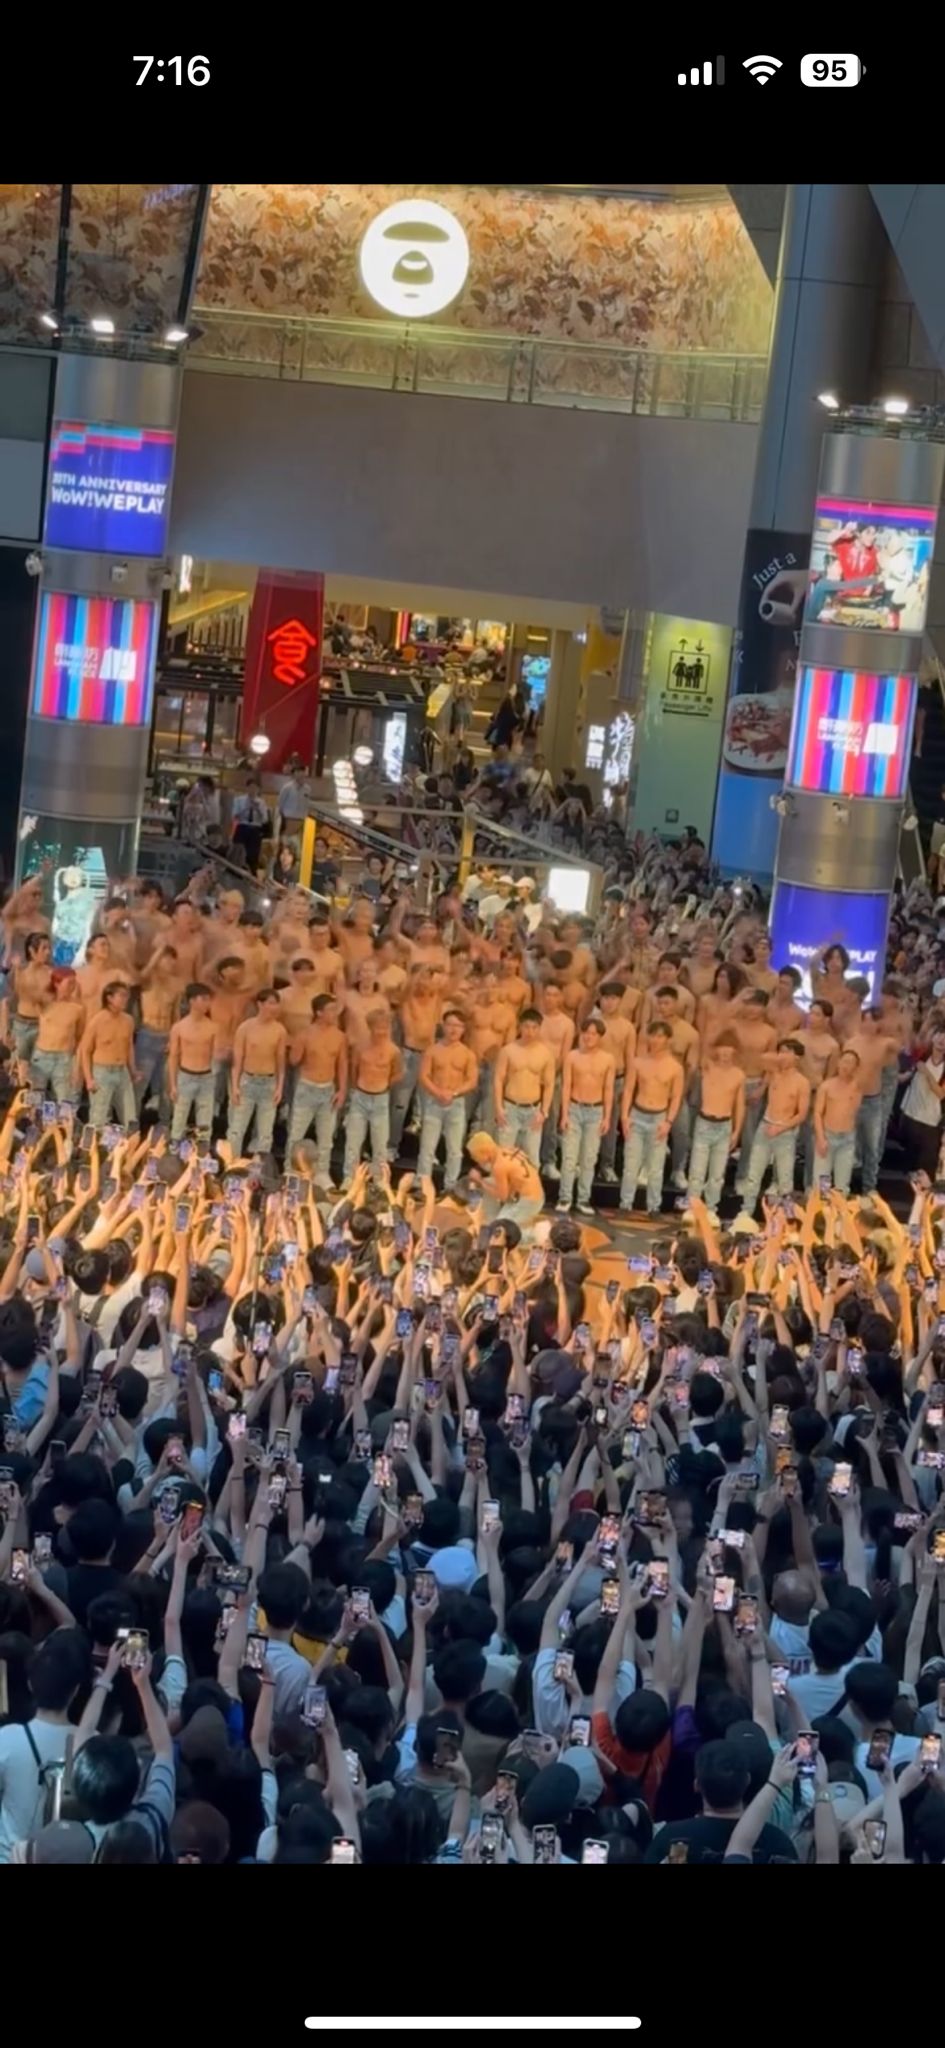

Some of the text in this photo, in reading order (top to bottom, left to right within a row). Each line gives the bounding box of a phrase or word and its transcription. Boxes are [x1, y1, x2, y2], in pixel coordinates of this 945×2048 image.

[79, 475, 167, 496] ANNIVERSARY
[752, 552, 798, 590] Just a
[268, 618, 317, 686] 食
